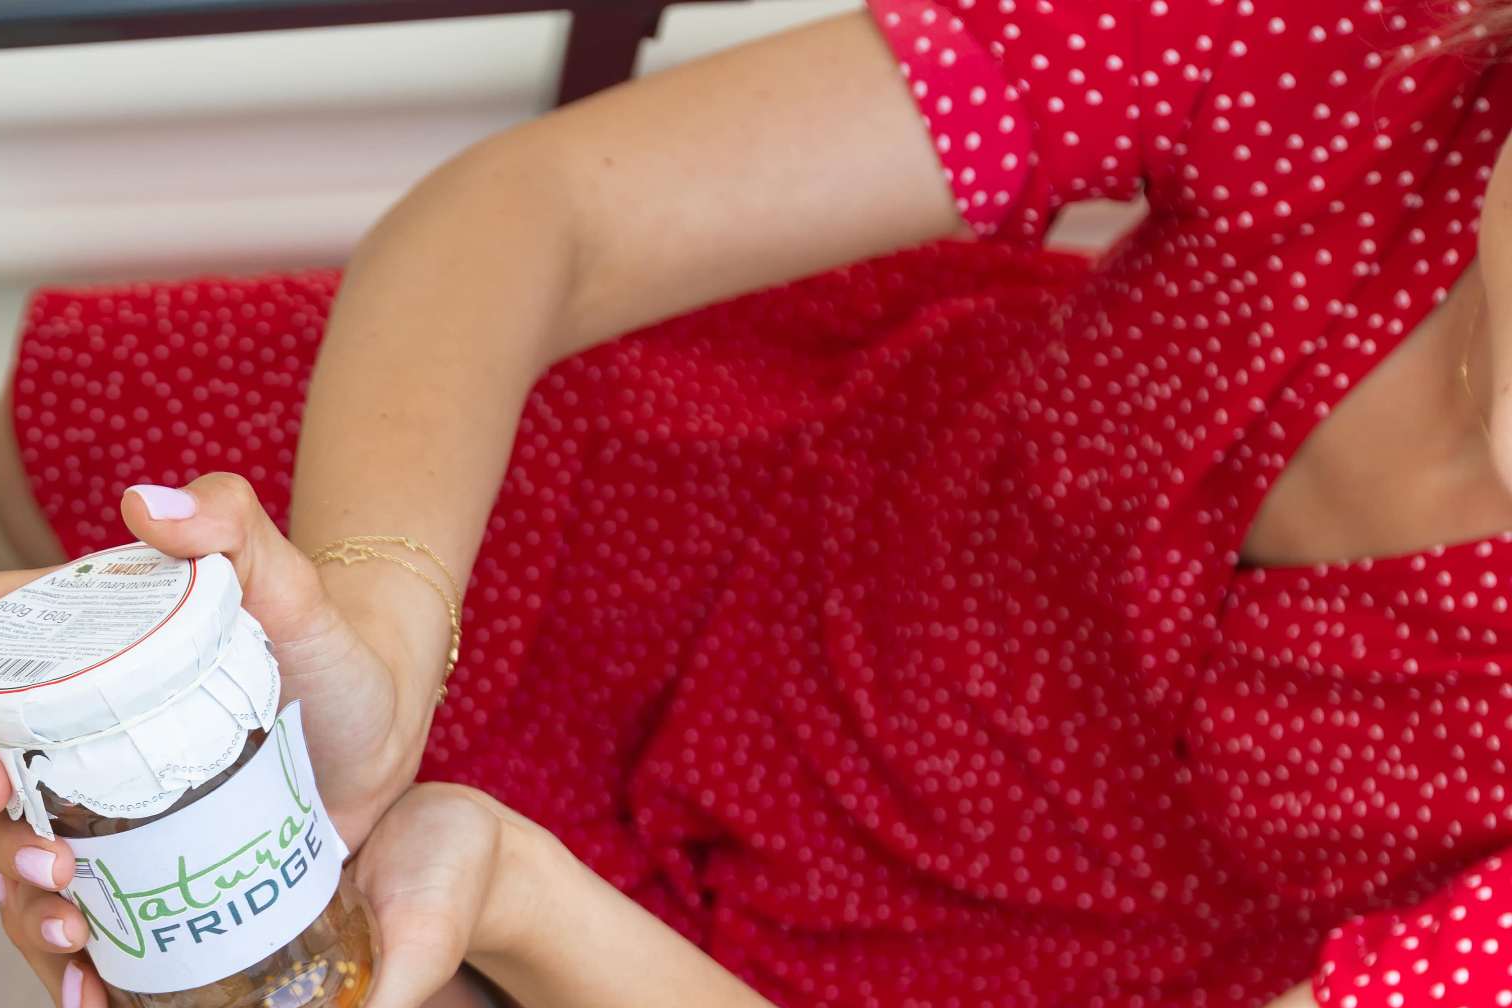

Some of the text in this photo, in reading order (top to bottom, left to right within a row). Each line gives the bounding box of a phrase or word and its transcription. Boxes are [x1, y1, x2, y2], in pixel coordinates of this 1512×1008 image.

[37, 609, 73, 624] 160g
[71, 718, 313, 960] Natural
[150, 822, 323, 954] FRIDGE
